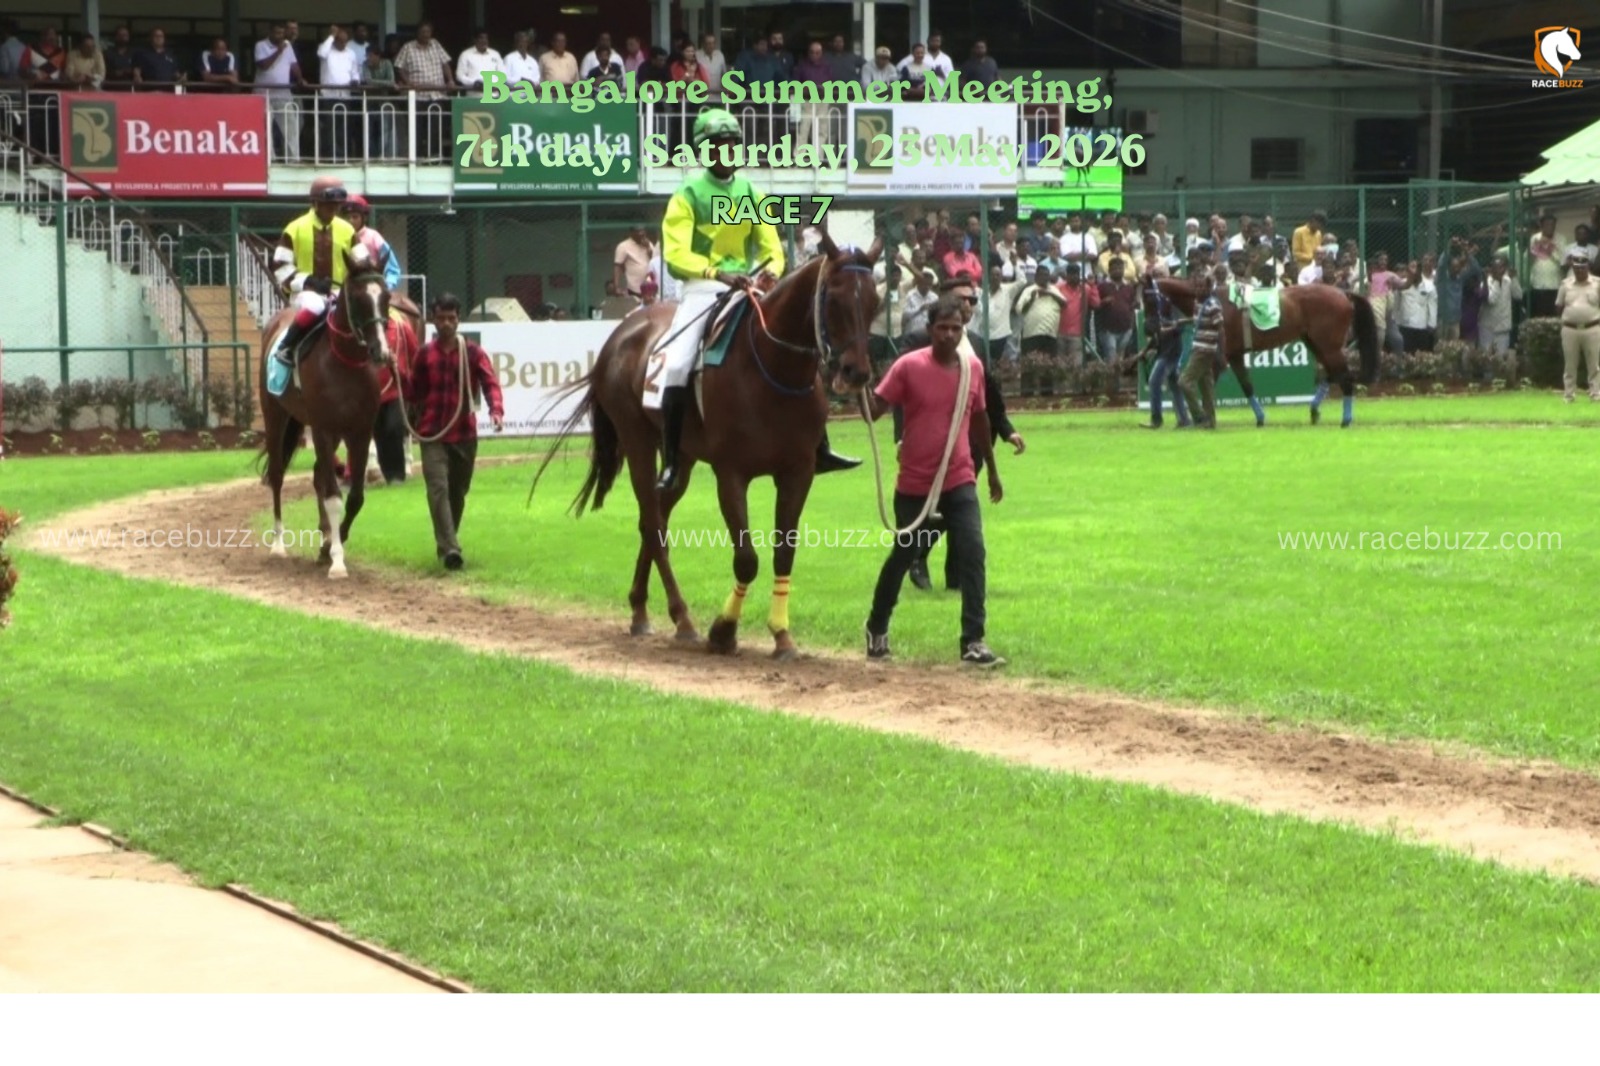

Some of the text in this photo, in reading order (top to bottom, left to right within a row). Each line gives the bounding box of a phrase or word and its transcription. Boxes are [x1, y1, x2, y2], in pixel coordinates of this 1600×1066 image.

[124, 119, 261, 155] Benaka
[508, 122, 632, 156] Benaka
[490, 350, 595, 389] Bena
[644, 352, 667, 394] 2
